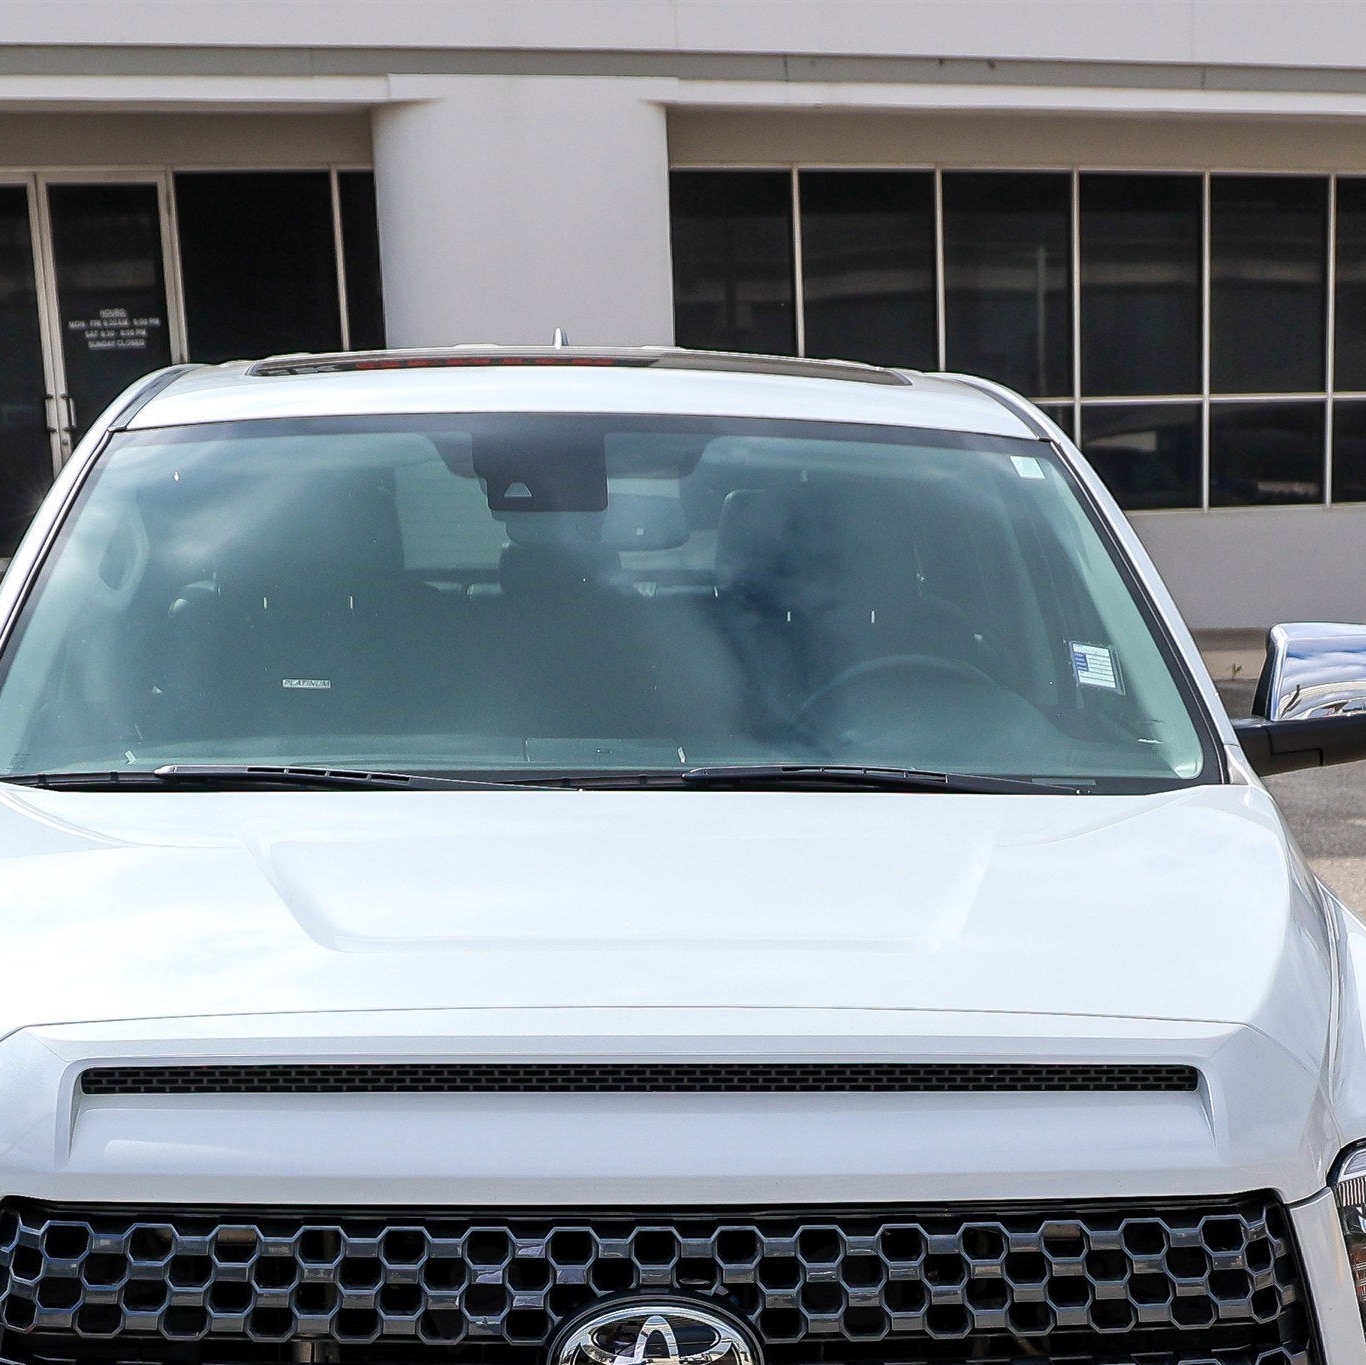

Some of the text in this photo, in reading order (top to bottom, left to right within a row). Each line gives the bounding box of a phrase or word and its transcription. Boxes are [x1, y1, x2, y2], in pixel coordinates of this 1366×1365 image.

[88, 339, 145, 348] SUNDAY CLOSED
[283, 679, 331, 688] PLATINUM
